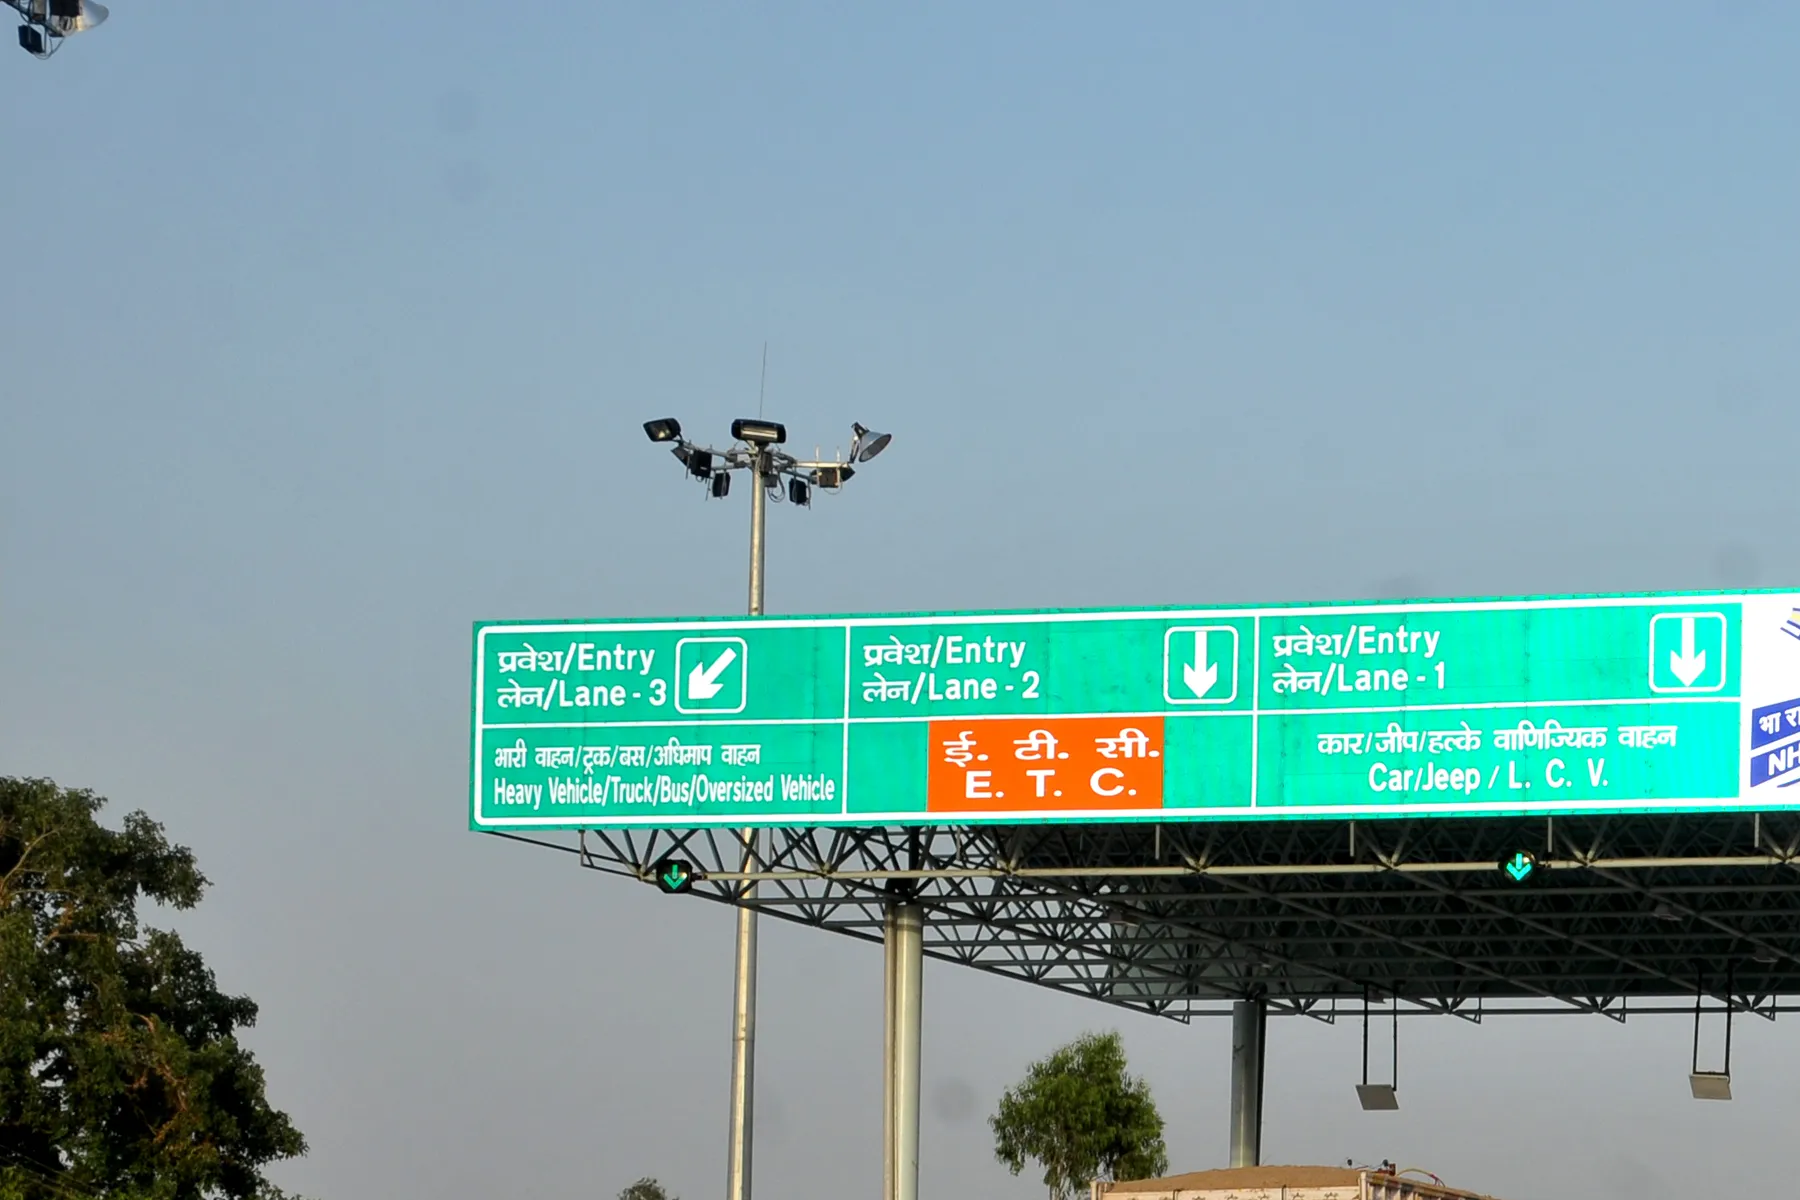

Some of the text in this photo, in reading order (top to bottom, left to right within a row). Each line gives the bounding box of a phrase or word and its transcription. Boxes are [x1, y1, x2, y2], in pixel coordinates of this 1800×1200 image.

[864, 636, 1025, 667] प्रवेश/Entry
[1274, 626, 1439, 657] प्रवेश/Entry
[499, 643, 654, 674] प्रवेश/Entry
[864, 673, 996, 703] लेन/Lane
[1023, 672, 1039, 697] 2
[1274, 664, 1408, 694] लेन/Lane
[1436, 662, 1444, 688] 1
[499, 680, 625, 710] लेन/Lane
[650, 680, 665, 705] 3
[1619, 726, 1677, 748] वाहन
[496, 740, 526, 767] भारी
[723, 745, 760, 764] वाहन
[966, 768, 1136, 798] E. T. C.
[1370, 763, 1480, 793] Car/Jeep
[1510, 762, 1530, 788] L.
[1546, 759, 1571, 787] C.
[1587, 757, 1609, 787] V.
[496, 775, 834, 808] Heavy Vehicle/Truck/Bus/Oversized Vehicle
